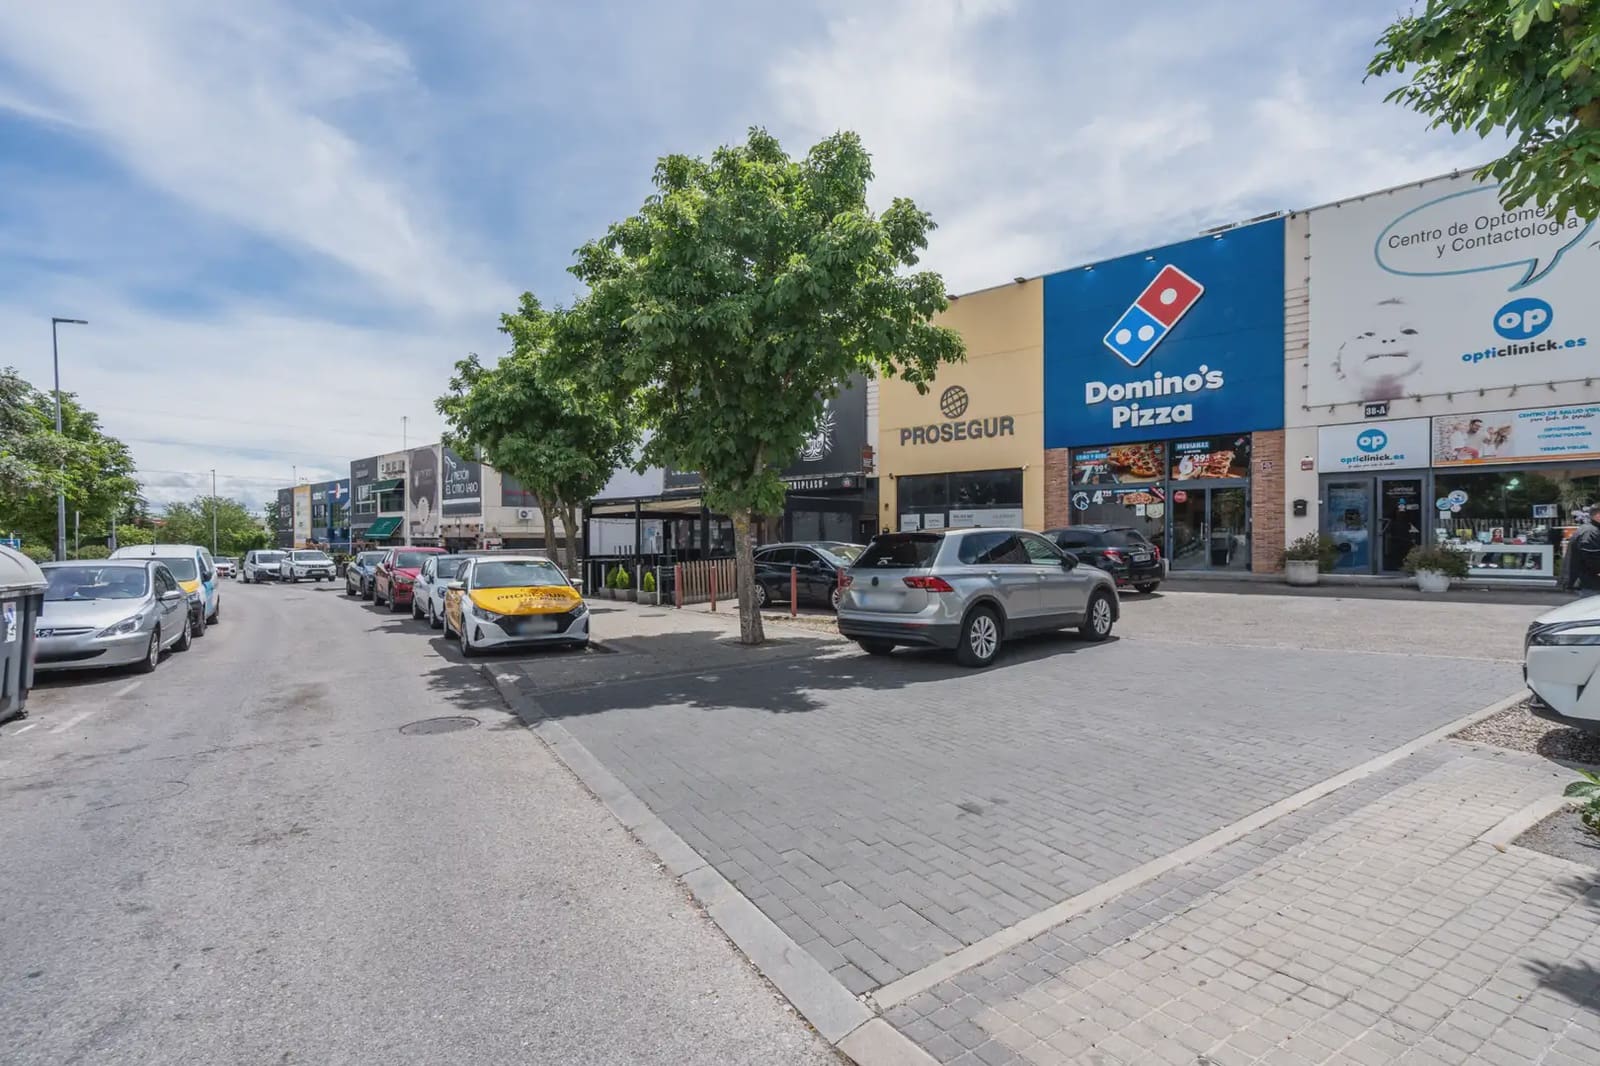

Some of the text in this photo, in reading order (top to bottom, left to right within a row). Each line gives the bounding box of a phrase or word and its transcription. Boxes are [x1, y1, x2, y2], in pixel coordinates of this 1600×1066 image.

[1388, 203, 1562, 249] Centro de Optomet
[1436, 243, 1446, 259] y
[1498, 308, 1548, 333] op
[1461, 337, 1588, 363] opticlinick.es
[1085, 364, 1225, 405] Domino's
[1112, 403, 1193, 429] Pizza
[900, 415, 1015, 447] PROSEGUR
[1340, 454, 1404, 465] opticlinick.es
